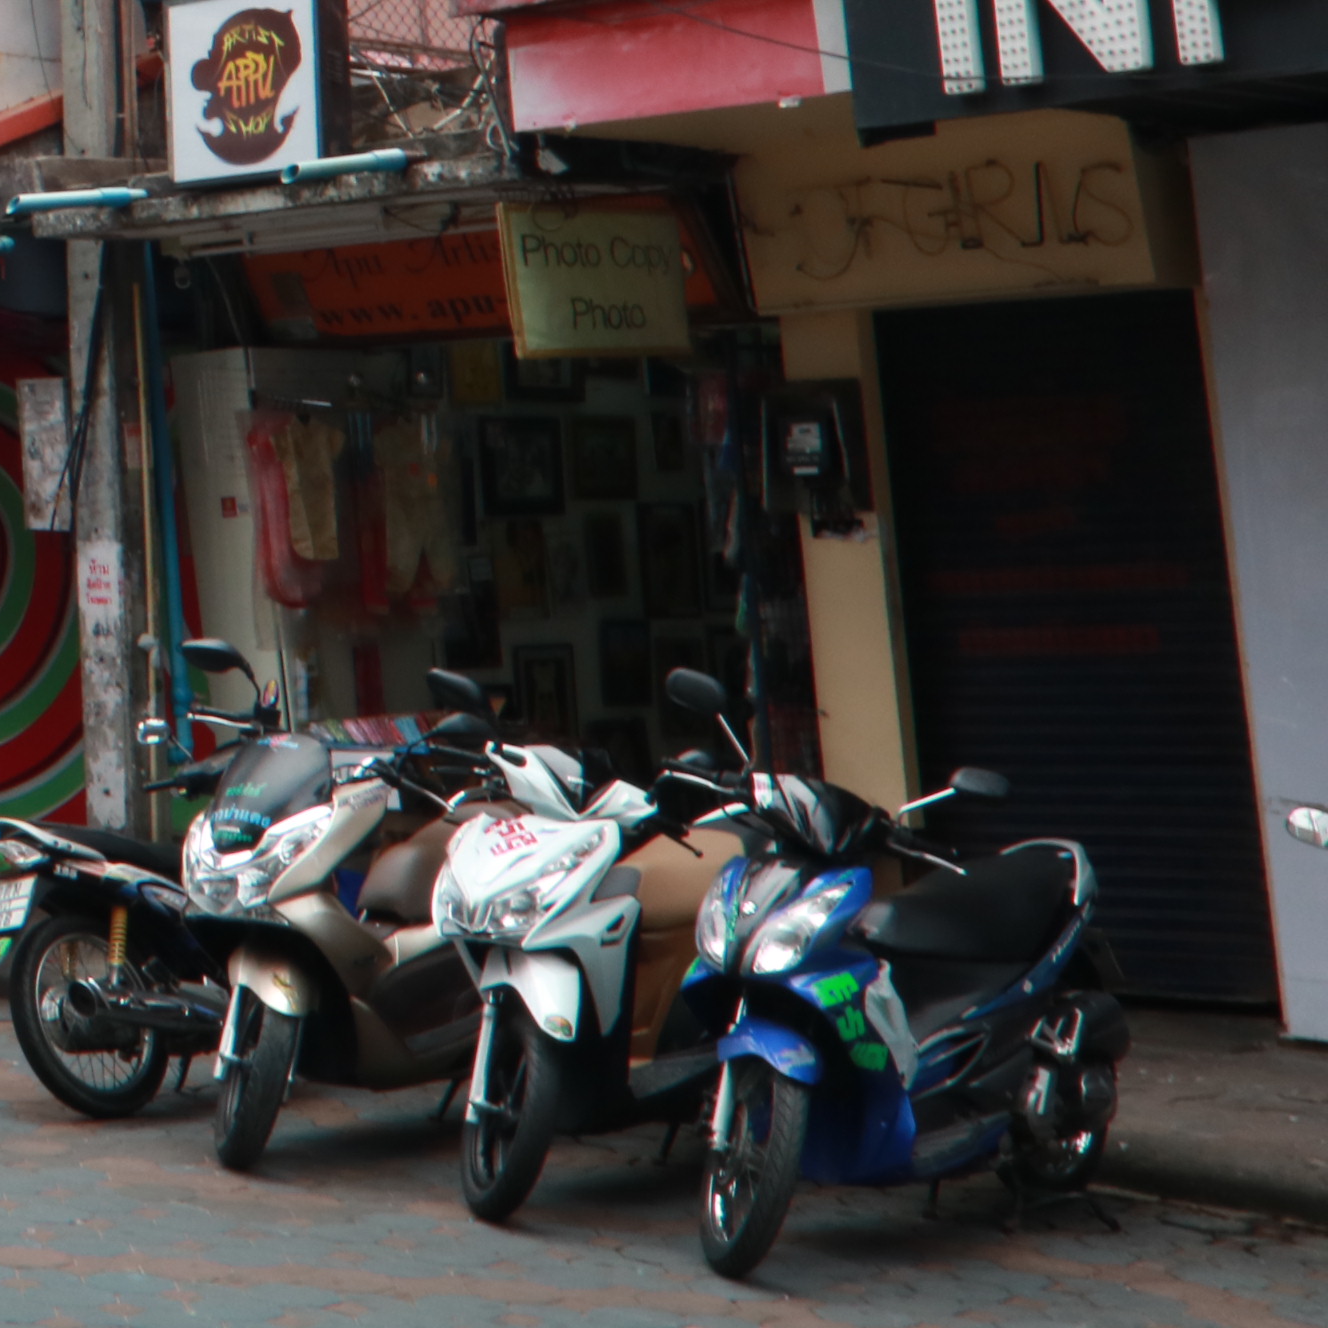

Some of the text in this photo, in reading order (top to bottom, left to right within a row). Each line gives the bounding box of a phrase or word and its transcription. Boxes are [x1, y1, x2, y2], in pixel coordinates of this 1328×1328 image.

[521, 234, 674, 277] Photo Copy
[571, 297, 647, 331] Photo
